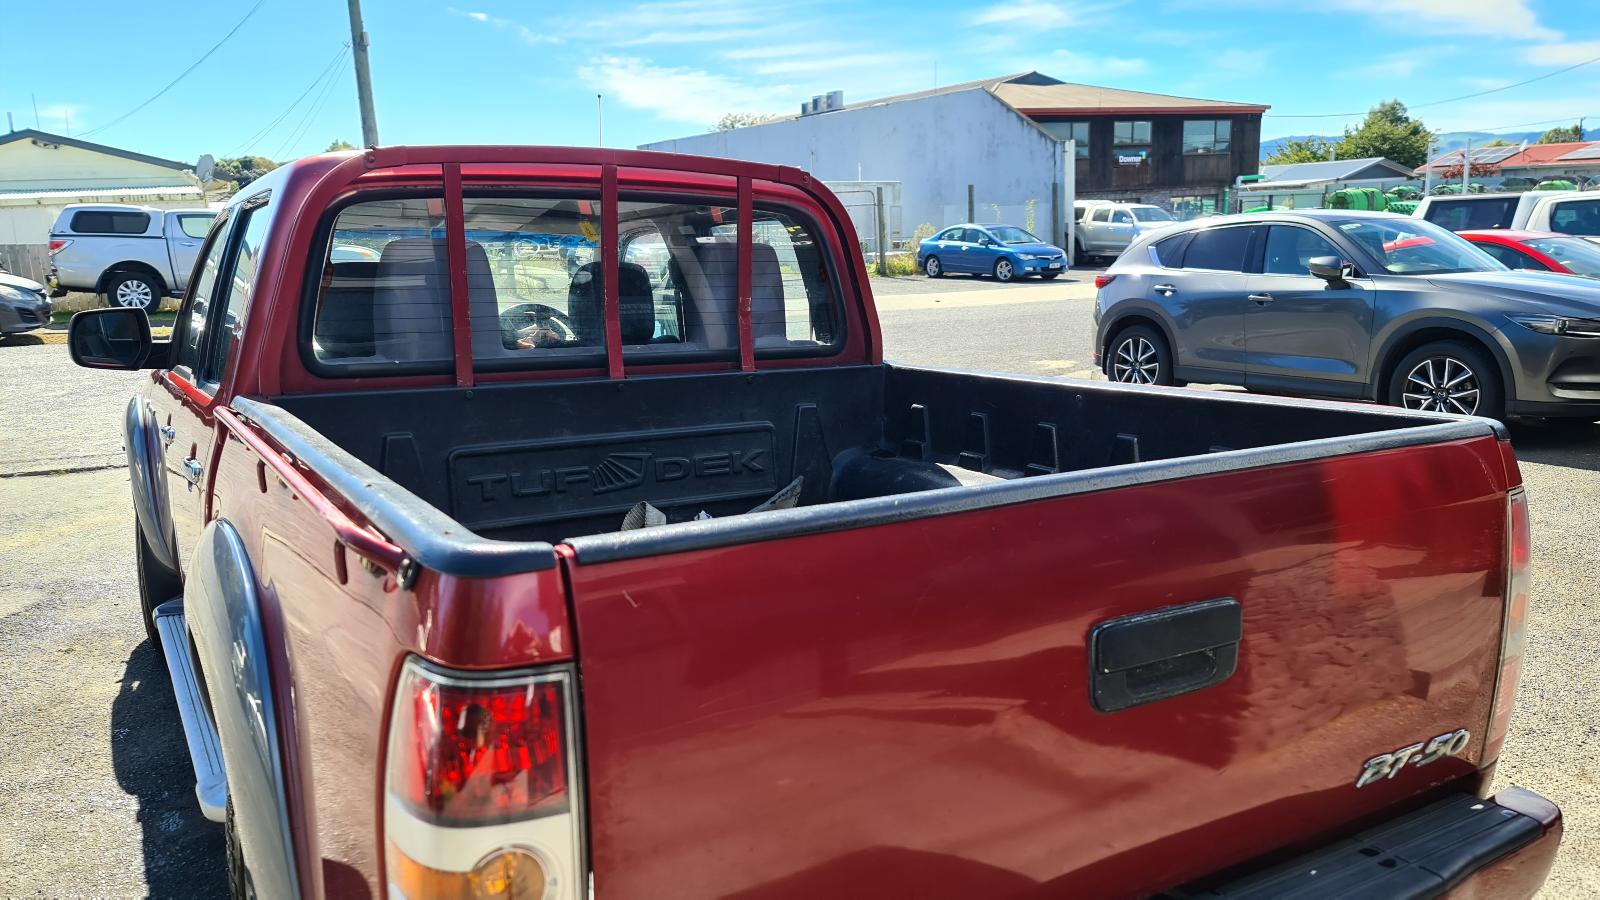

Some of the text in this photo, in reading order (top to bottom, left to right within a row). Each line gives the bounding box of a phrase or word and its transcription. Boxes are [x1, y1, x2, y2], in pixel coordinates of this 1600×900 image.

[467, 450, 765, 502] TUF DEK
[1355, 728, 1471, 788] BT-50
